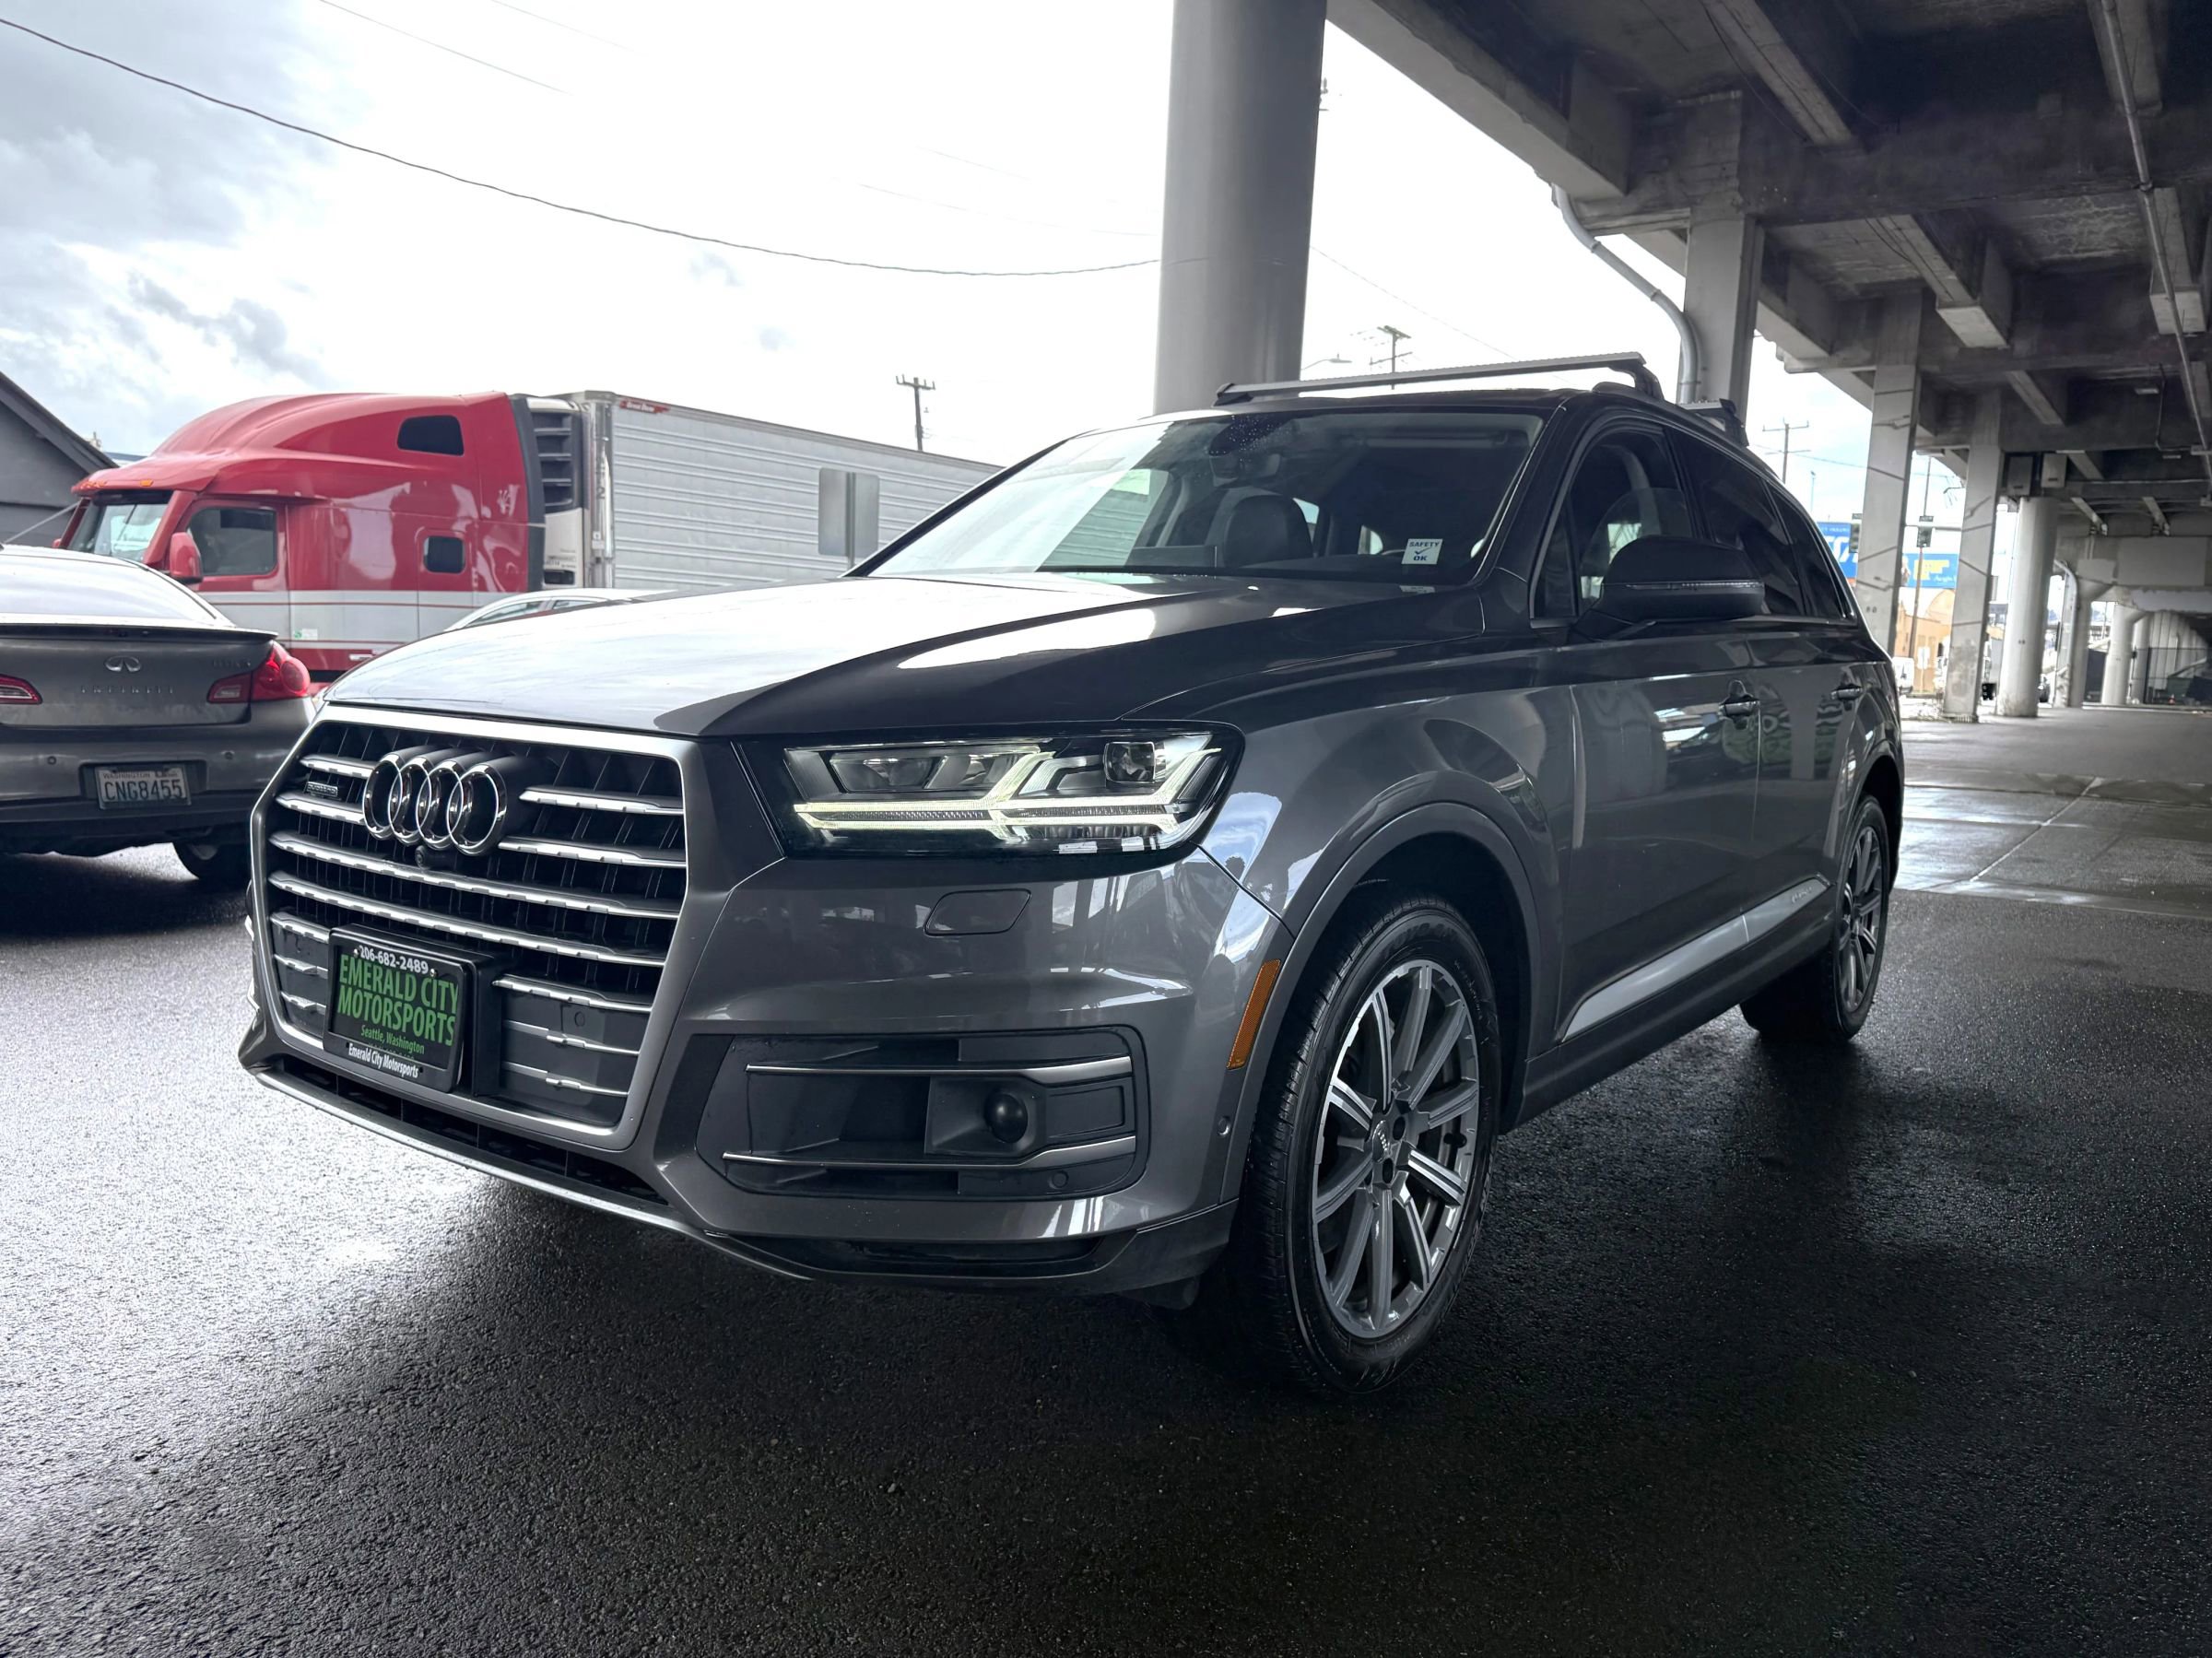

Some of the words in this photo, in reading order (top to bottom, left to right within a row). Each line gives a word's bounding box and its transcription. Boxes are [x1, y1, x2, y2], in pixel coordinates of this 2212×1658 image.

[80, 685, 174, 694] INFINITI
[104, 779, 182, 800] CNG8455
[359, 945, 429, 974] 206-682-2489
[339, 954, 418, 1002] EMERALD
[421, 977, 458, 1014] CITY
[337, 985, 456, 1046] MOTORSPORTS
[360, 1024, 385, 1043] Seattle,
[386, 1030, 425, 1054] Washington
[348, 1042, 371, 1062] Emerald
[371, 1051, 383, 1069] City
[382, 1053, 419, 1078] Motorsports
